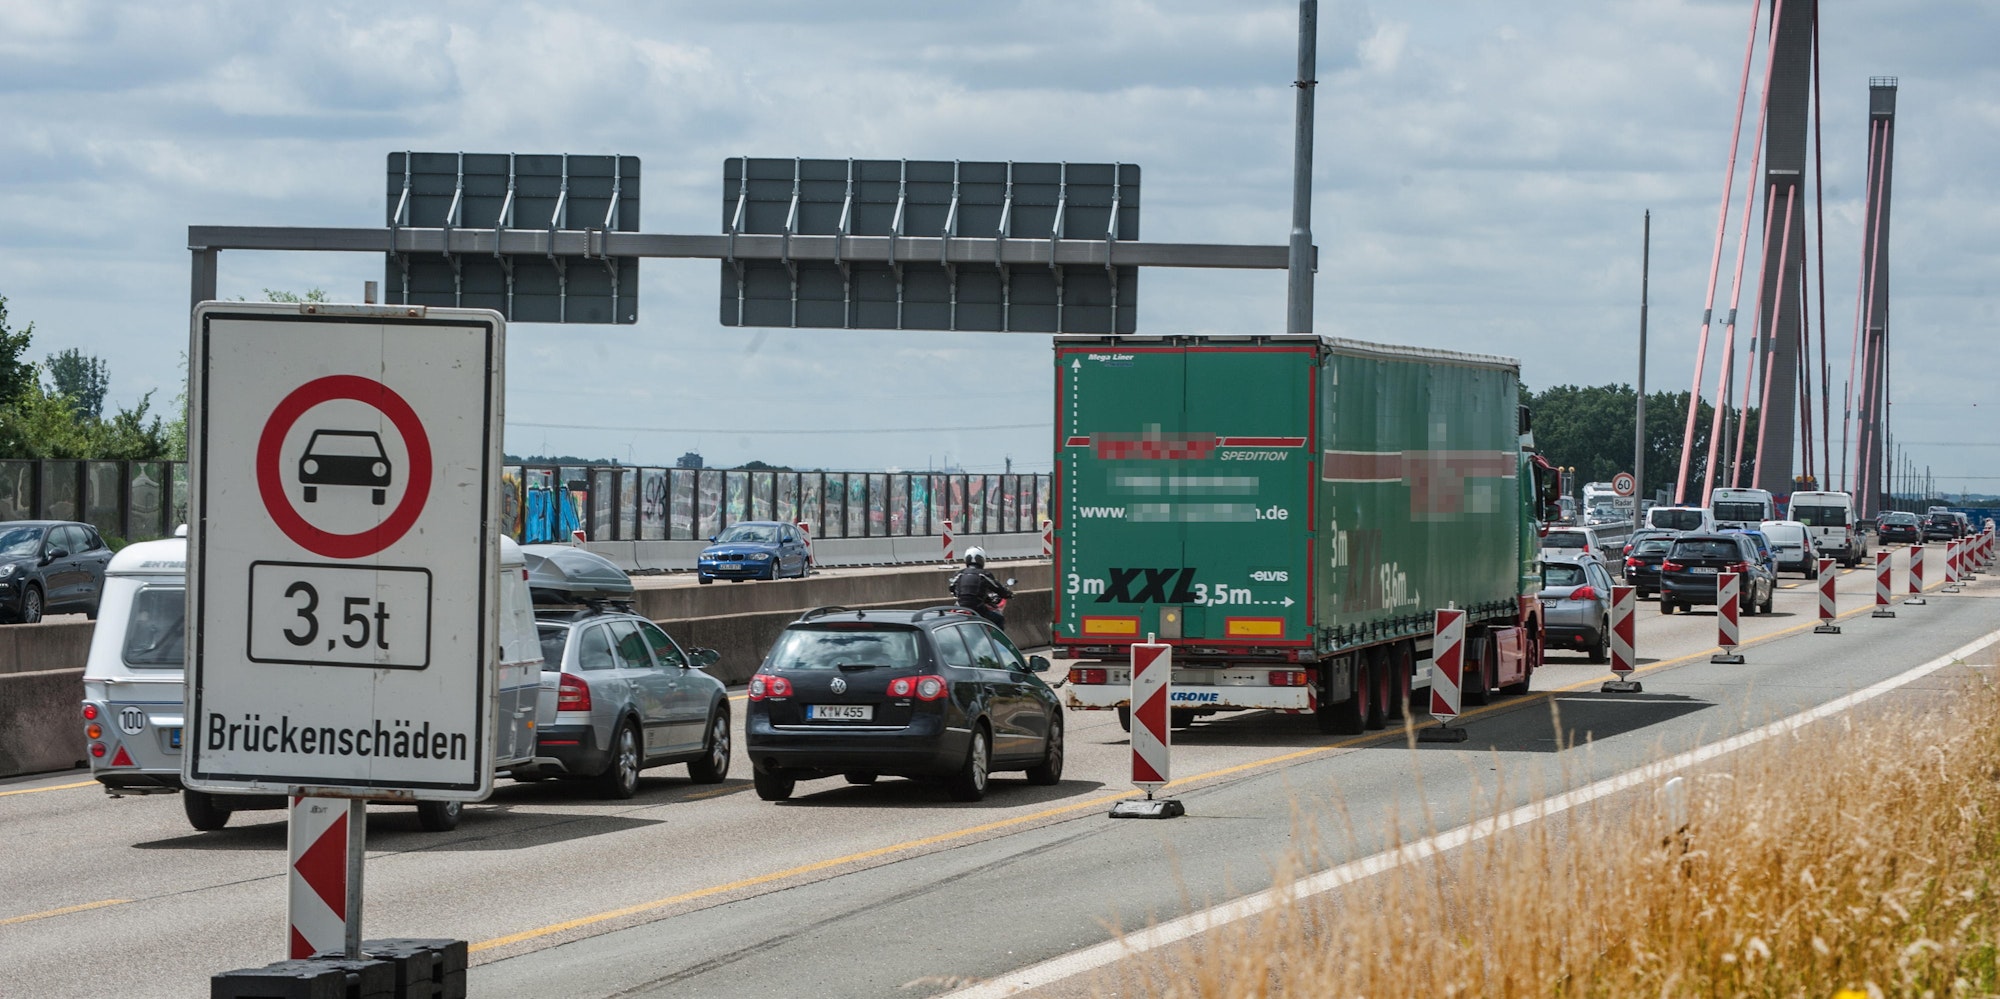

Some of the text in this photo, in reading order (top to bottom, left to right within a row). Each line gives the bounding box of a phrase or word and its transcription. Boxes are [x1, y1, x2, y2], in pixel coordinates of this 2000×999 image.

[1088, 353, 1134, 362] Mega Liner
[1220, 451, 1288, 461] SPEDITION
[1617, 479, 1630, 490] 60
[1614, 499, 1632, 507] Radar
[1094, 567, 1197, 603] XXL
[1193, 583, 1251, 607] 3,5m
[1380, 561, 1407, 614] 13,6m
[283, 580, 390, 652] 3,5t
[819, 706, 864, 718] K W 455
[121, 711, 143, 729] 100
[207, 712, 467, 760] Brückenschäden
